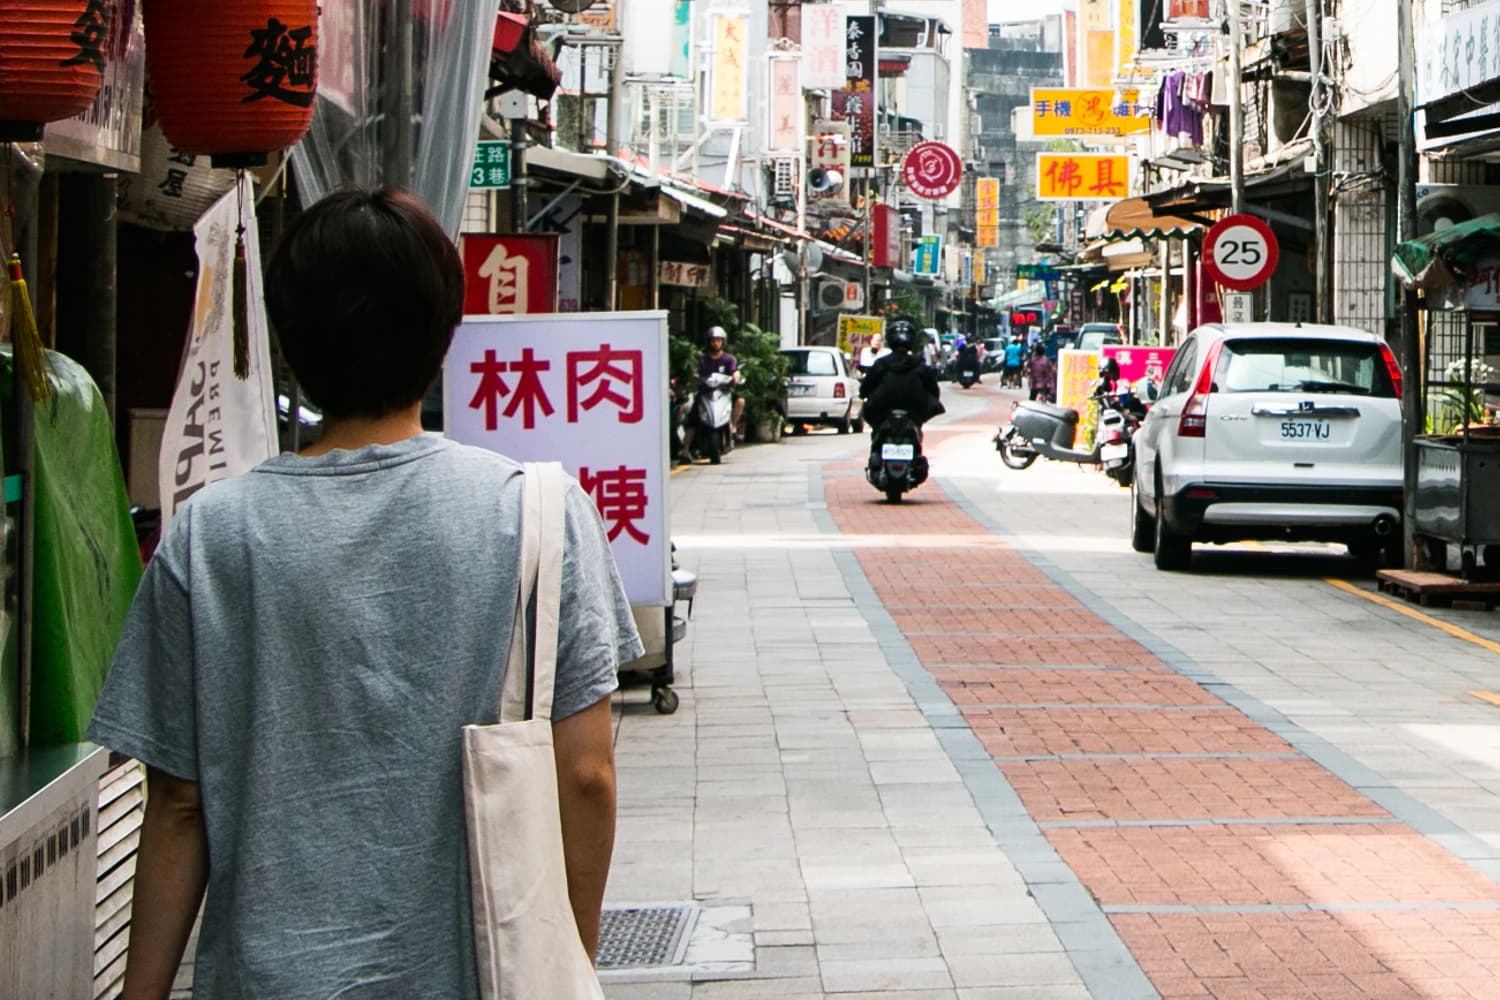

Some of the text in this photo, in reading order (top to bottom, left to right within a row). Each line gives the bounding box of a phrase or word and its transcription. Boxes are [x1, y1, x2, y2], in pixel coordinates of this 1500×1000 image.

[1034, 99, 1072, 118] 手機
[1044, 156, 1125, 197] 佛具
[1220, 240, 1261, 265] 25
